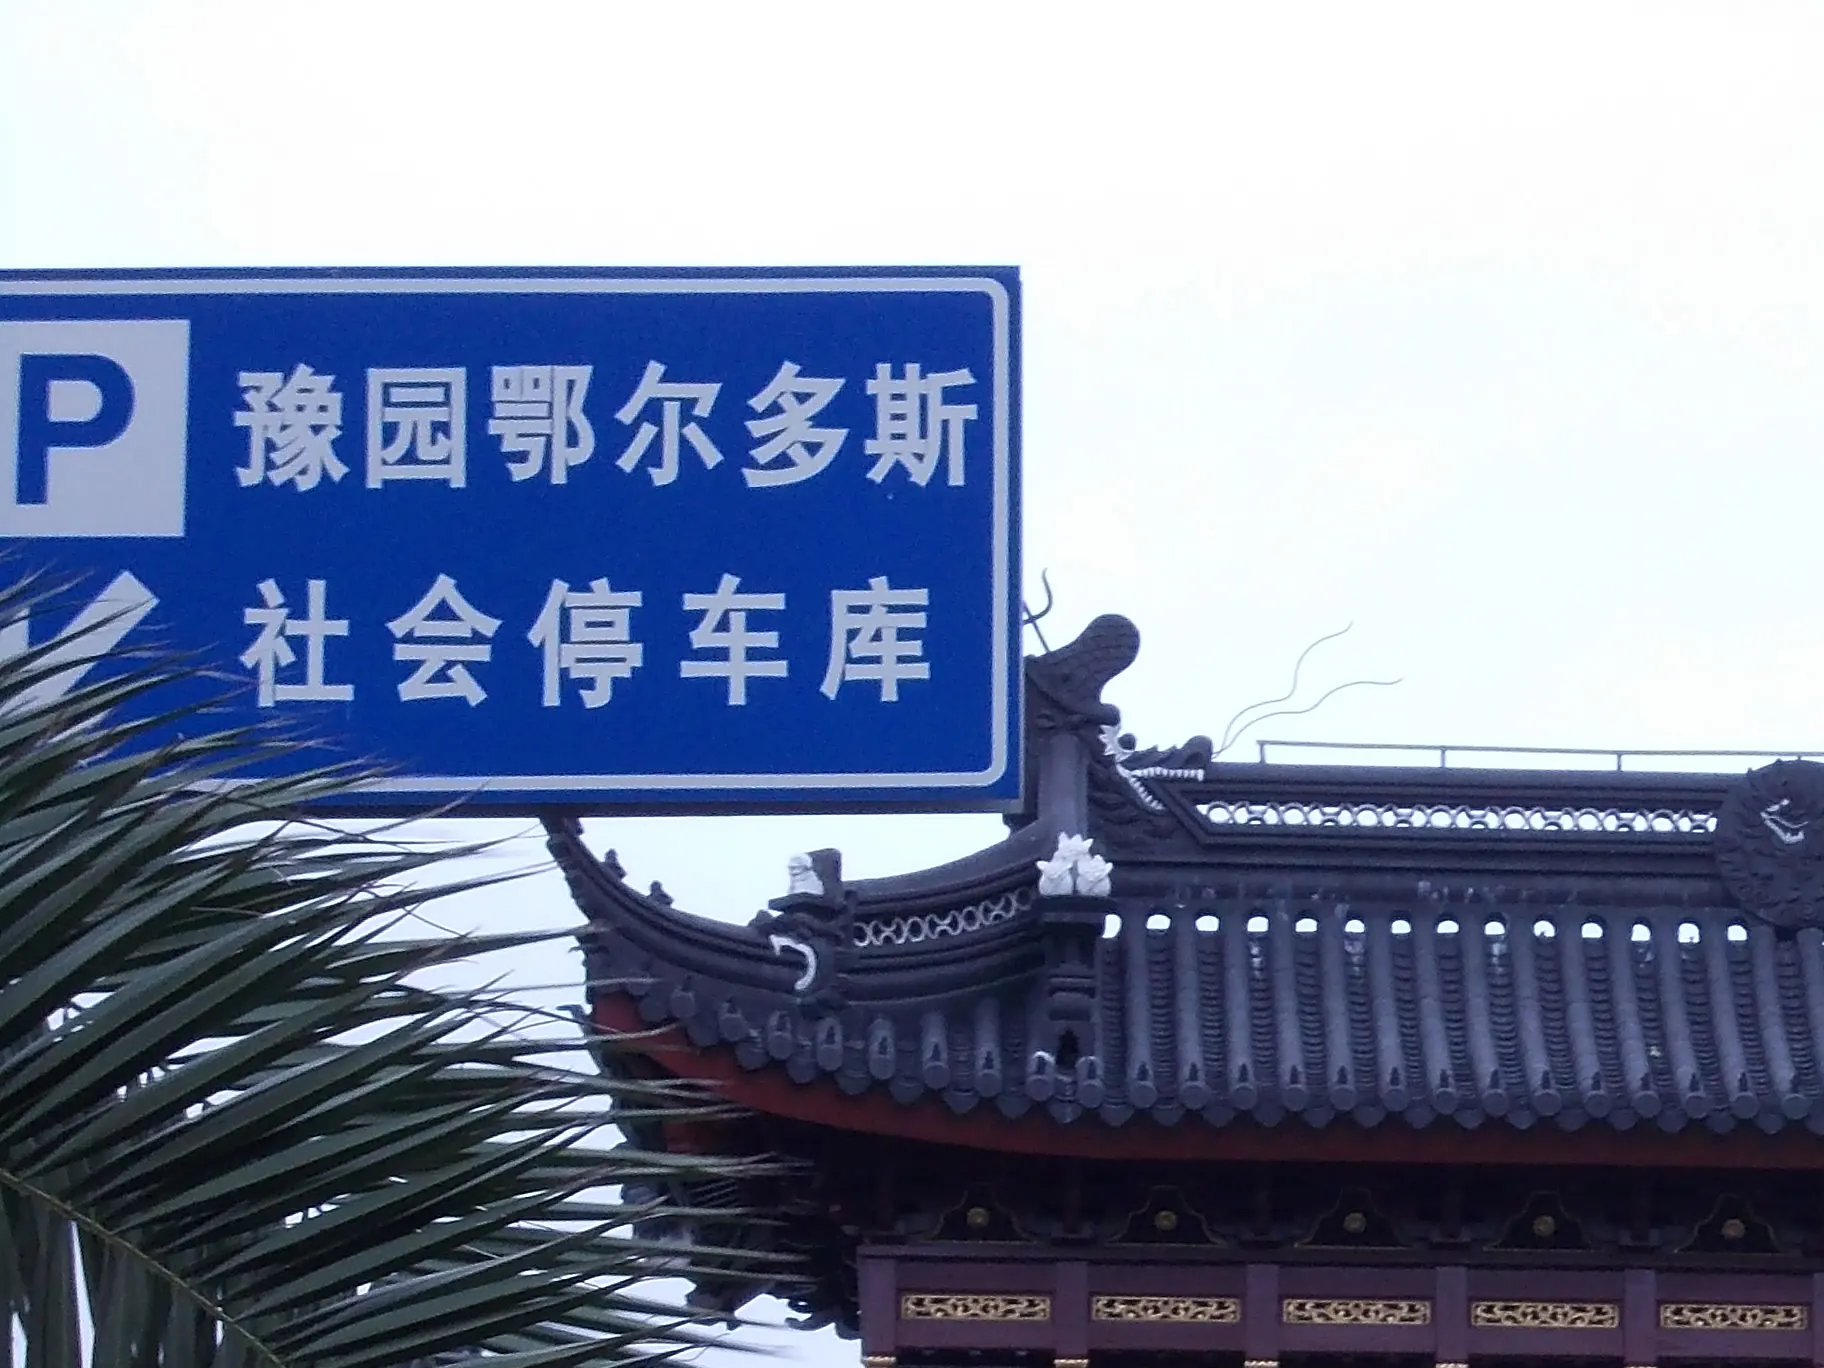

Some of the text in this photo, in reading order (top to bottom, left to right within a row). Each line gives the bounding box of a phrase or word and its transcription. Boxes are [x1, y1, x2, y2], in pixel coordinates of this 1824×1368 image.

[16, 354, 135, 505] P
[233, 361, 979, 492] 豫园鄂尔多斯
[240, 572, 931, 709] 社会停车库
